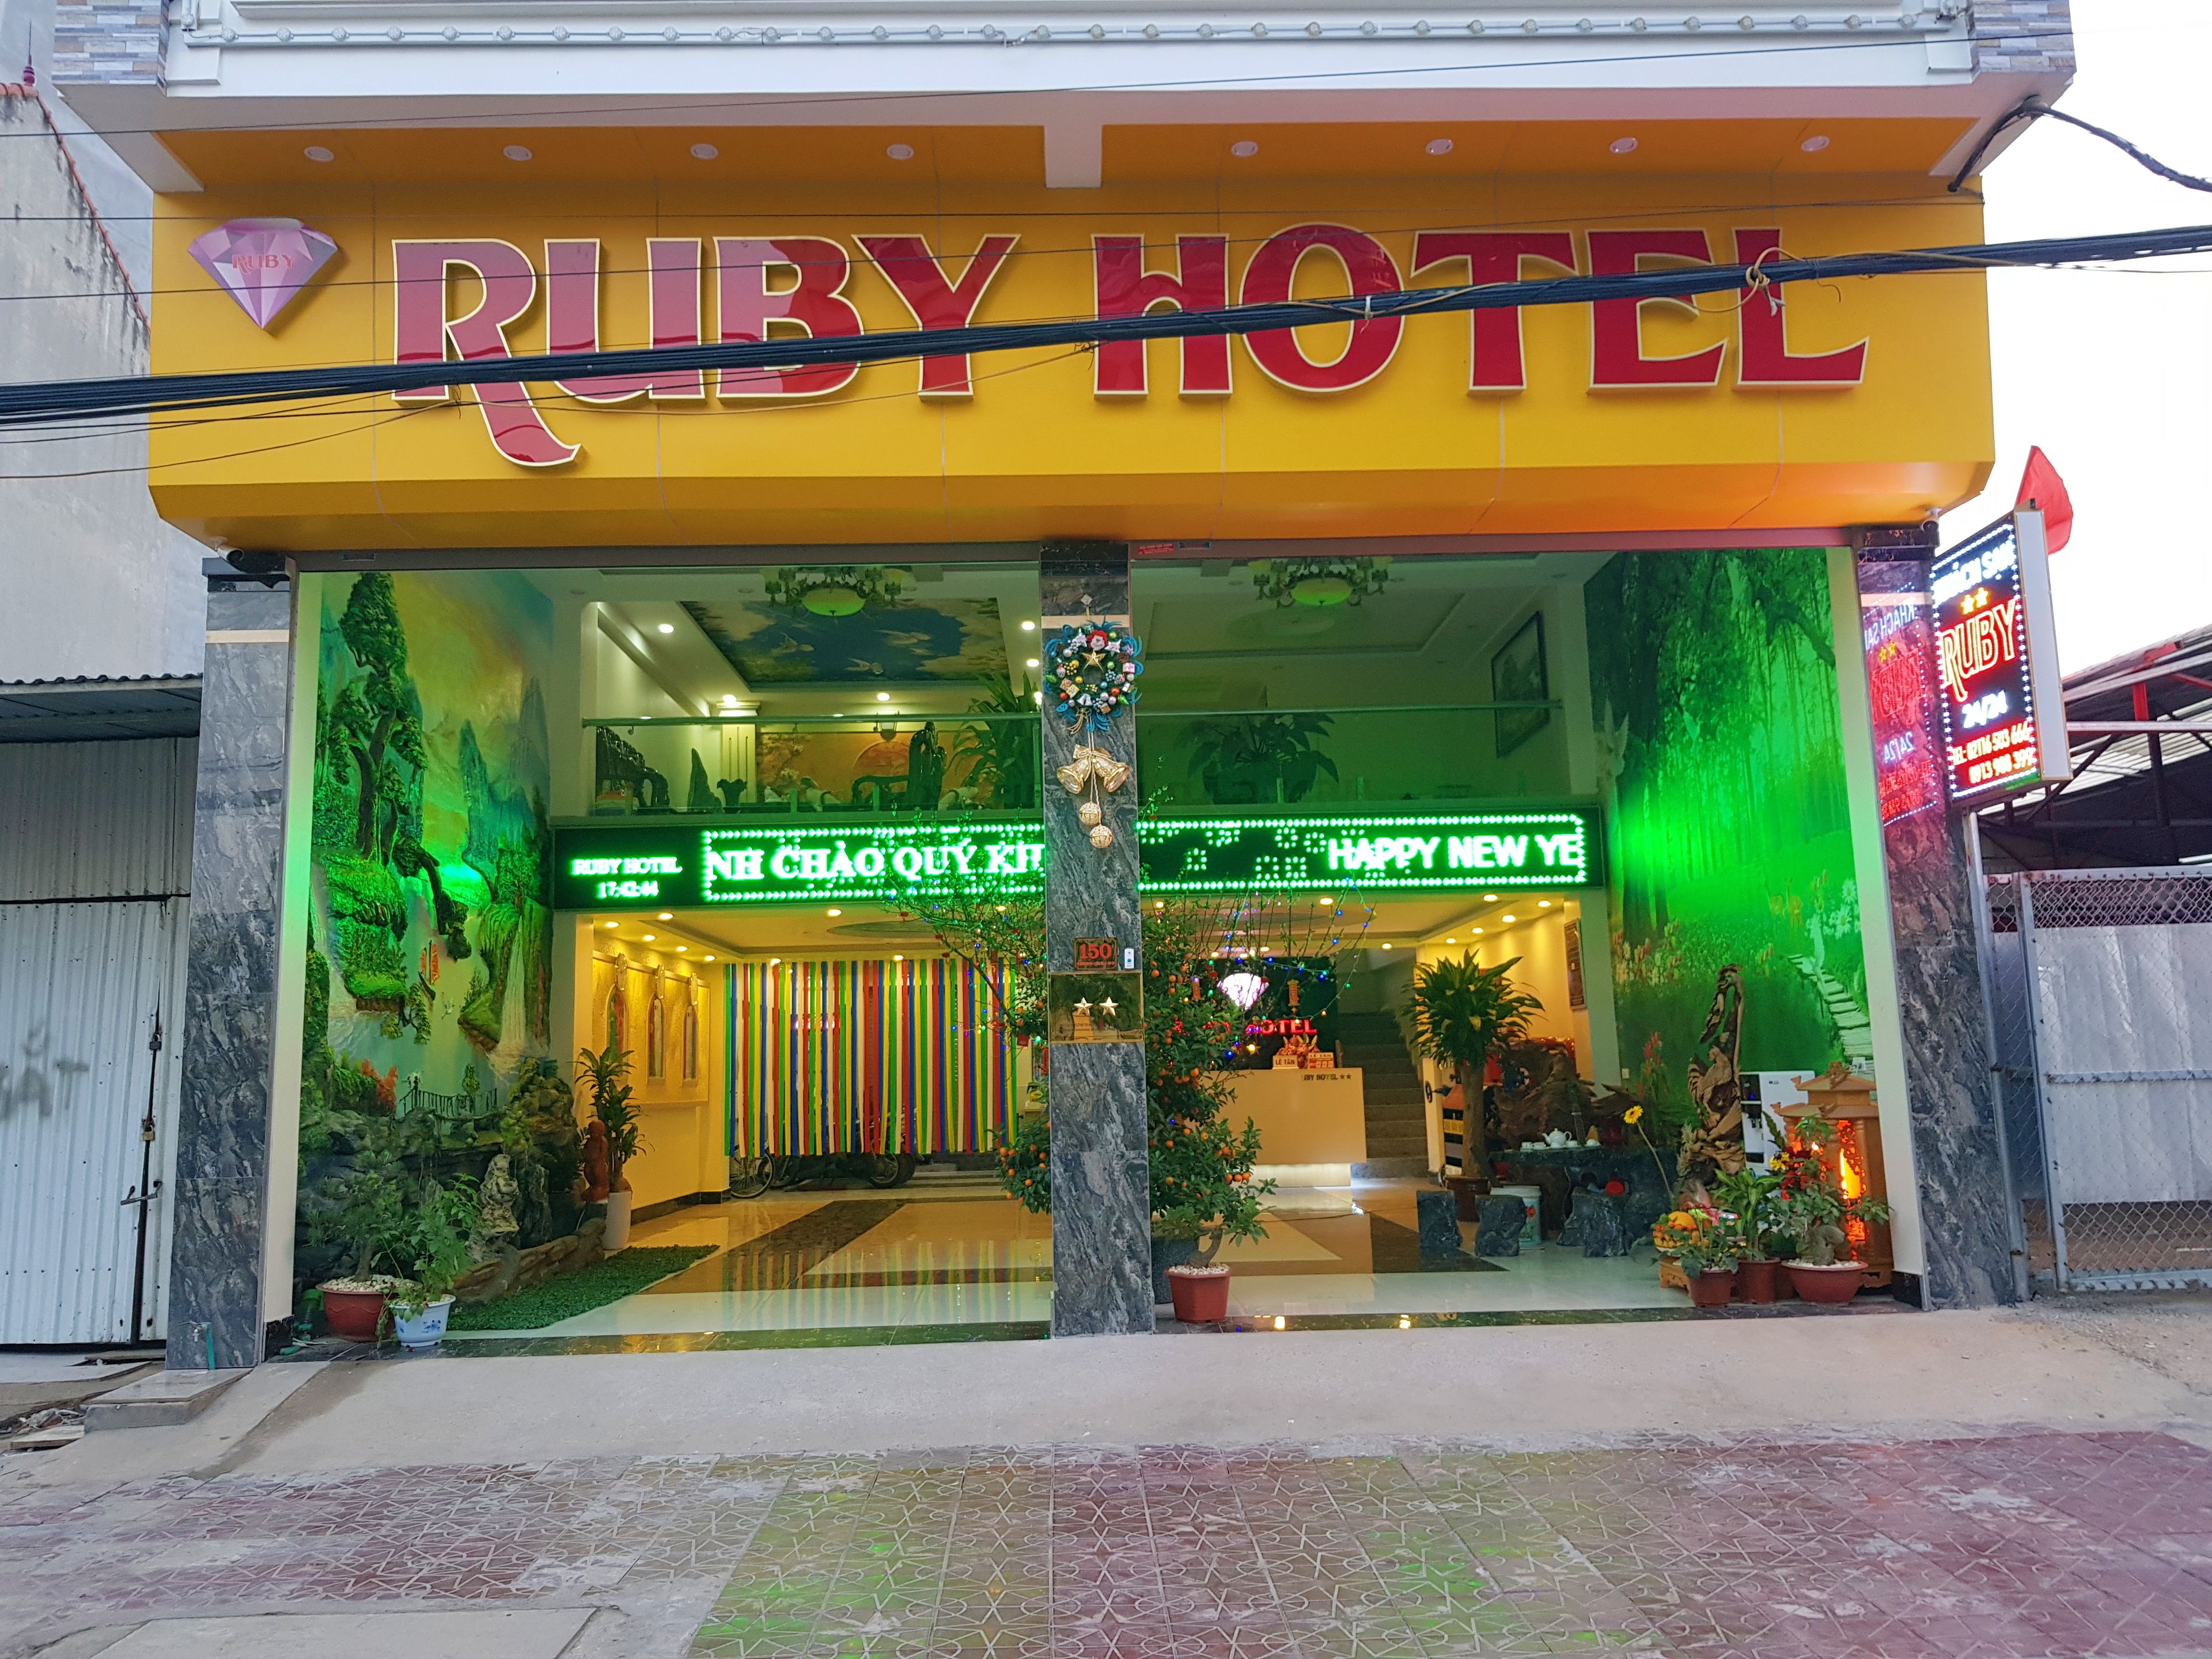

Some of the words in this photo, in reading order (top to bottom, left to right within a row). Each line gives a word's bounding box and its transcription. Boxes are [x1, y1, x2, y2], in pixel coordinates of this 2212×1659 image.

[232, 253, 293, 275] RUBY
[392, 233, 1021, 467] RUBY
[1092, 222, 1870, 397] HOTEL
[1941, 598, 2016, 702] RUBY
[1962, 690, 2008, 729] 24/24
[571, 858, 623, 875] RUBY
[623, 857, 683, 874] HOTEL
[893, 838, 978, 881] QUÝ
[1328, 836, 1440, 869] HAPPY
[1448, 835, 1528, 868] NEW
[1080, 943, 1112, 959] 150
